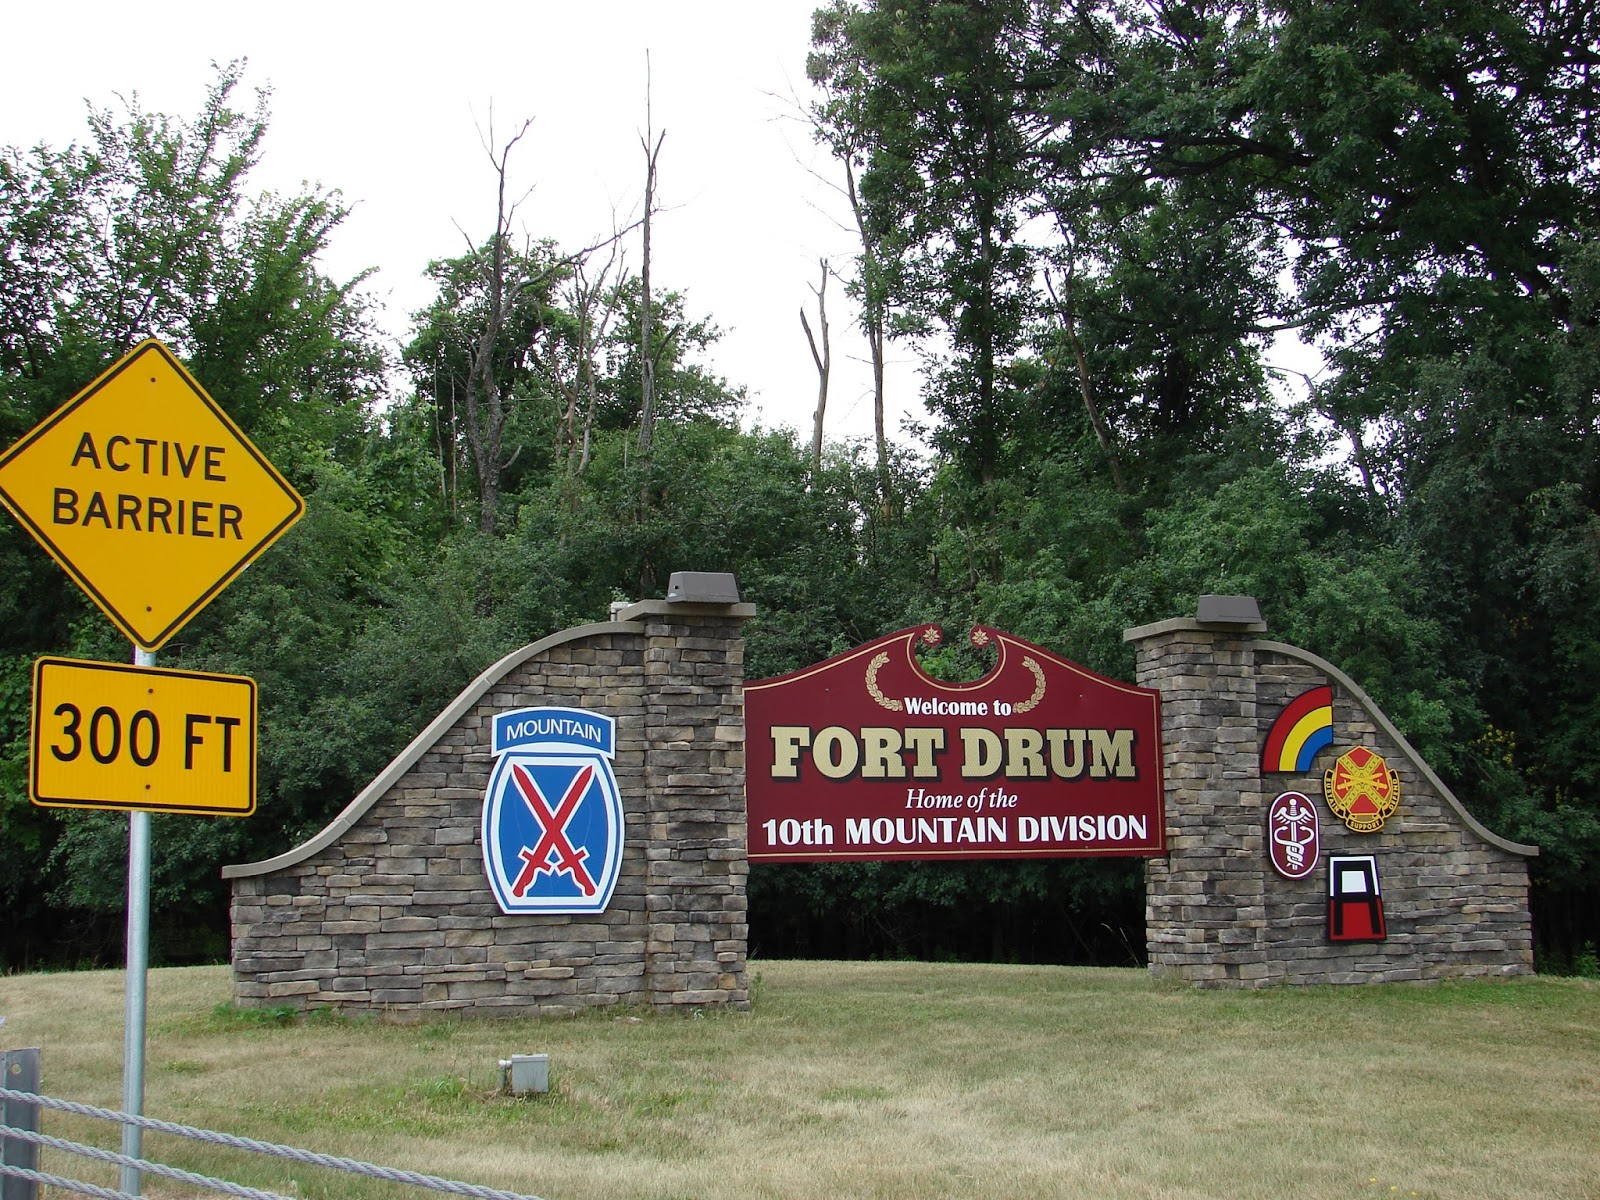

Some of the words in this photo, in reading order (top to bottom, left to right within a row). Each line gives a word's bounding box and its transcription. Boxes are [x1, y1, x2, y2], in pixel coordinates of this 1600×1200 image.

[71, 432, 226, 482] ACTIVE
[53, 487, 244, 540] BARRIER
[904, 697, 988, 716] Welcome
[993, 699, 1012, 717] to
[50, 702, 161, 767] 300
[184, 713, 241, 773] FT
[506, 718, 602, 743] MOUNTAIN
[770, 726, 944, 779] FORT
[960, 728, 1135, 779] DRUM
[905, 789, 963, 809] Home
[966, 788, 988, 812] of
[988, 791, 1018, 808] the
[1326, 778, 1340, 813] SUSTAIN
[1389, 778, 1399, 810] DEFEND
[762, 818, 834, 845] 10th
[845, 817, 1007, 844] MOUNTAIN
[1018, 814, 1147, 842] DIVISION
[1350, 820, 1380, 830] SUPPORT
